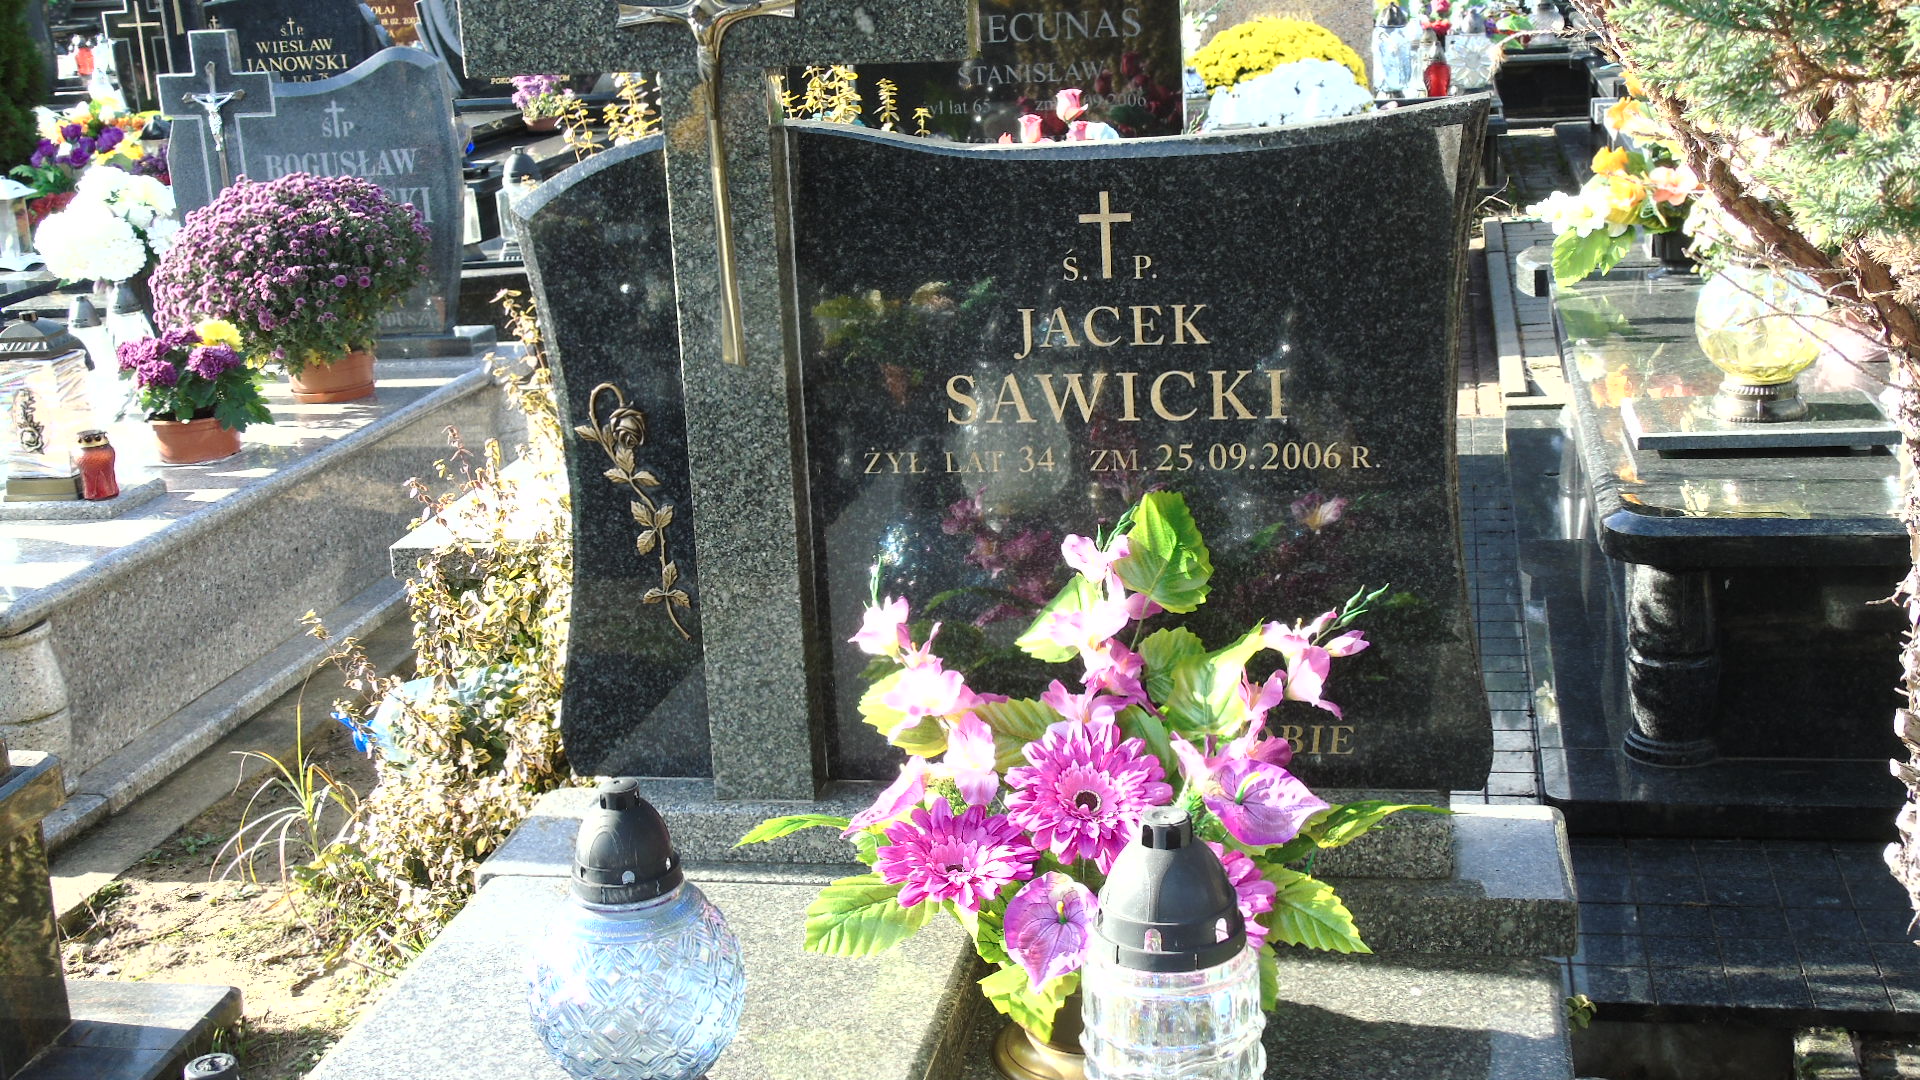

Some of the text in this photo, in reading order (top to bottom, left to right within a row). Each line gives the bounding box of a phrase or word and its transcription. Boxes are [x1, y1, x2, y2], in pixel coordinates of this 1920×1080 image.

[982, 7, 1142, 43] ECUNAS
[957, 60, 1105, 88] STANISŁAW
[973, 98, 991, 113] 65
[264, 148, 417, 181] BOGUSŁAW
[1062, 248, 1158, 281] Ś. P.
[1013, 304, 1211, 360] JACEK
[945, 369, 1289, 426] SAWICKI
[863, 446, 927, 474] ŻYŁ
[944, 451, 1005, 473] LAT
[1018, 444, 1056, 473] 34
[1089, 448, 1149, 473] ZM.
[1350, 445, 1381, 469] R.
